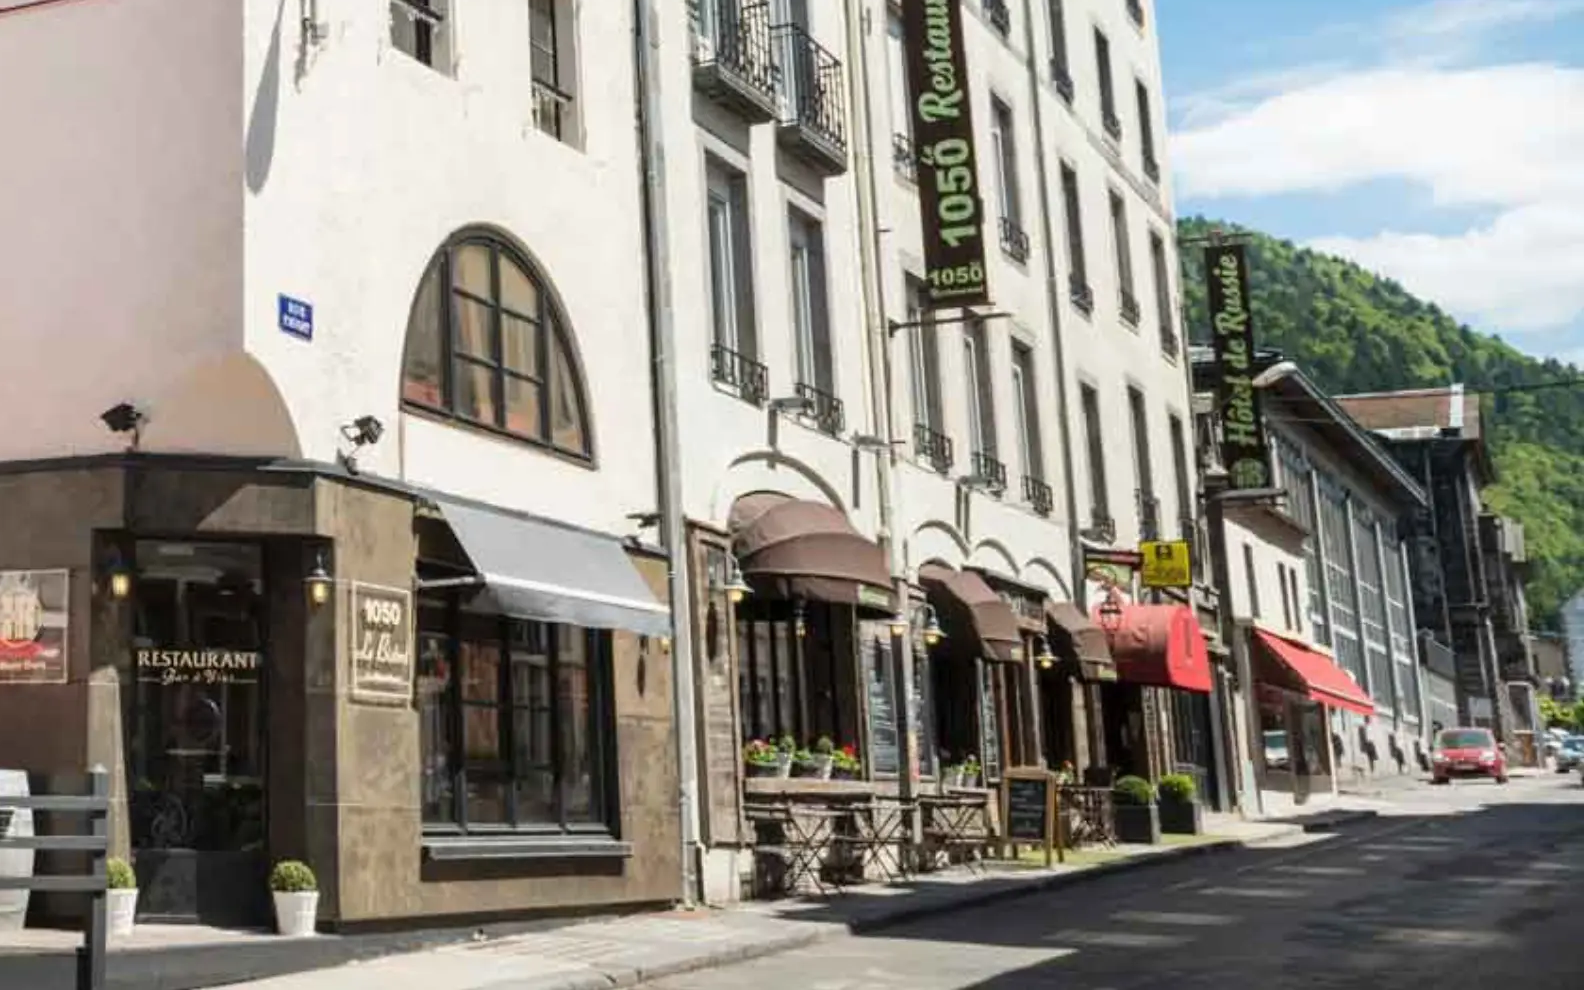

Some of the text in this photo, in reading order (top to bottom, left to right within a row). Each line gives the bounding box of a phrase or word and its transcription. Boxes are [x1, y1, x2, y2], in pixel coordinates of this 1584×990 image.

[933, 138, 978, 248] 1050
[928, 266, 983, 286] 1050
[1213, 254, 1248, 335] Russie
[1222, 338, 1247, 369] de
[364, 597, 401, 625] 1050
[137, 650, 257, 668] RESTAURANT
